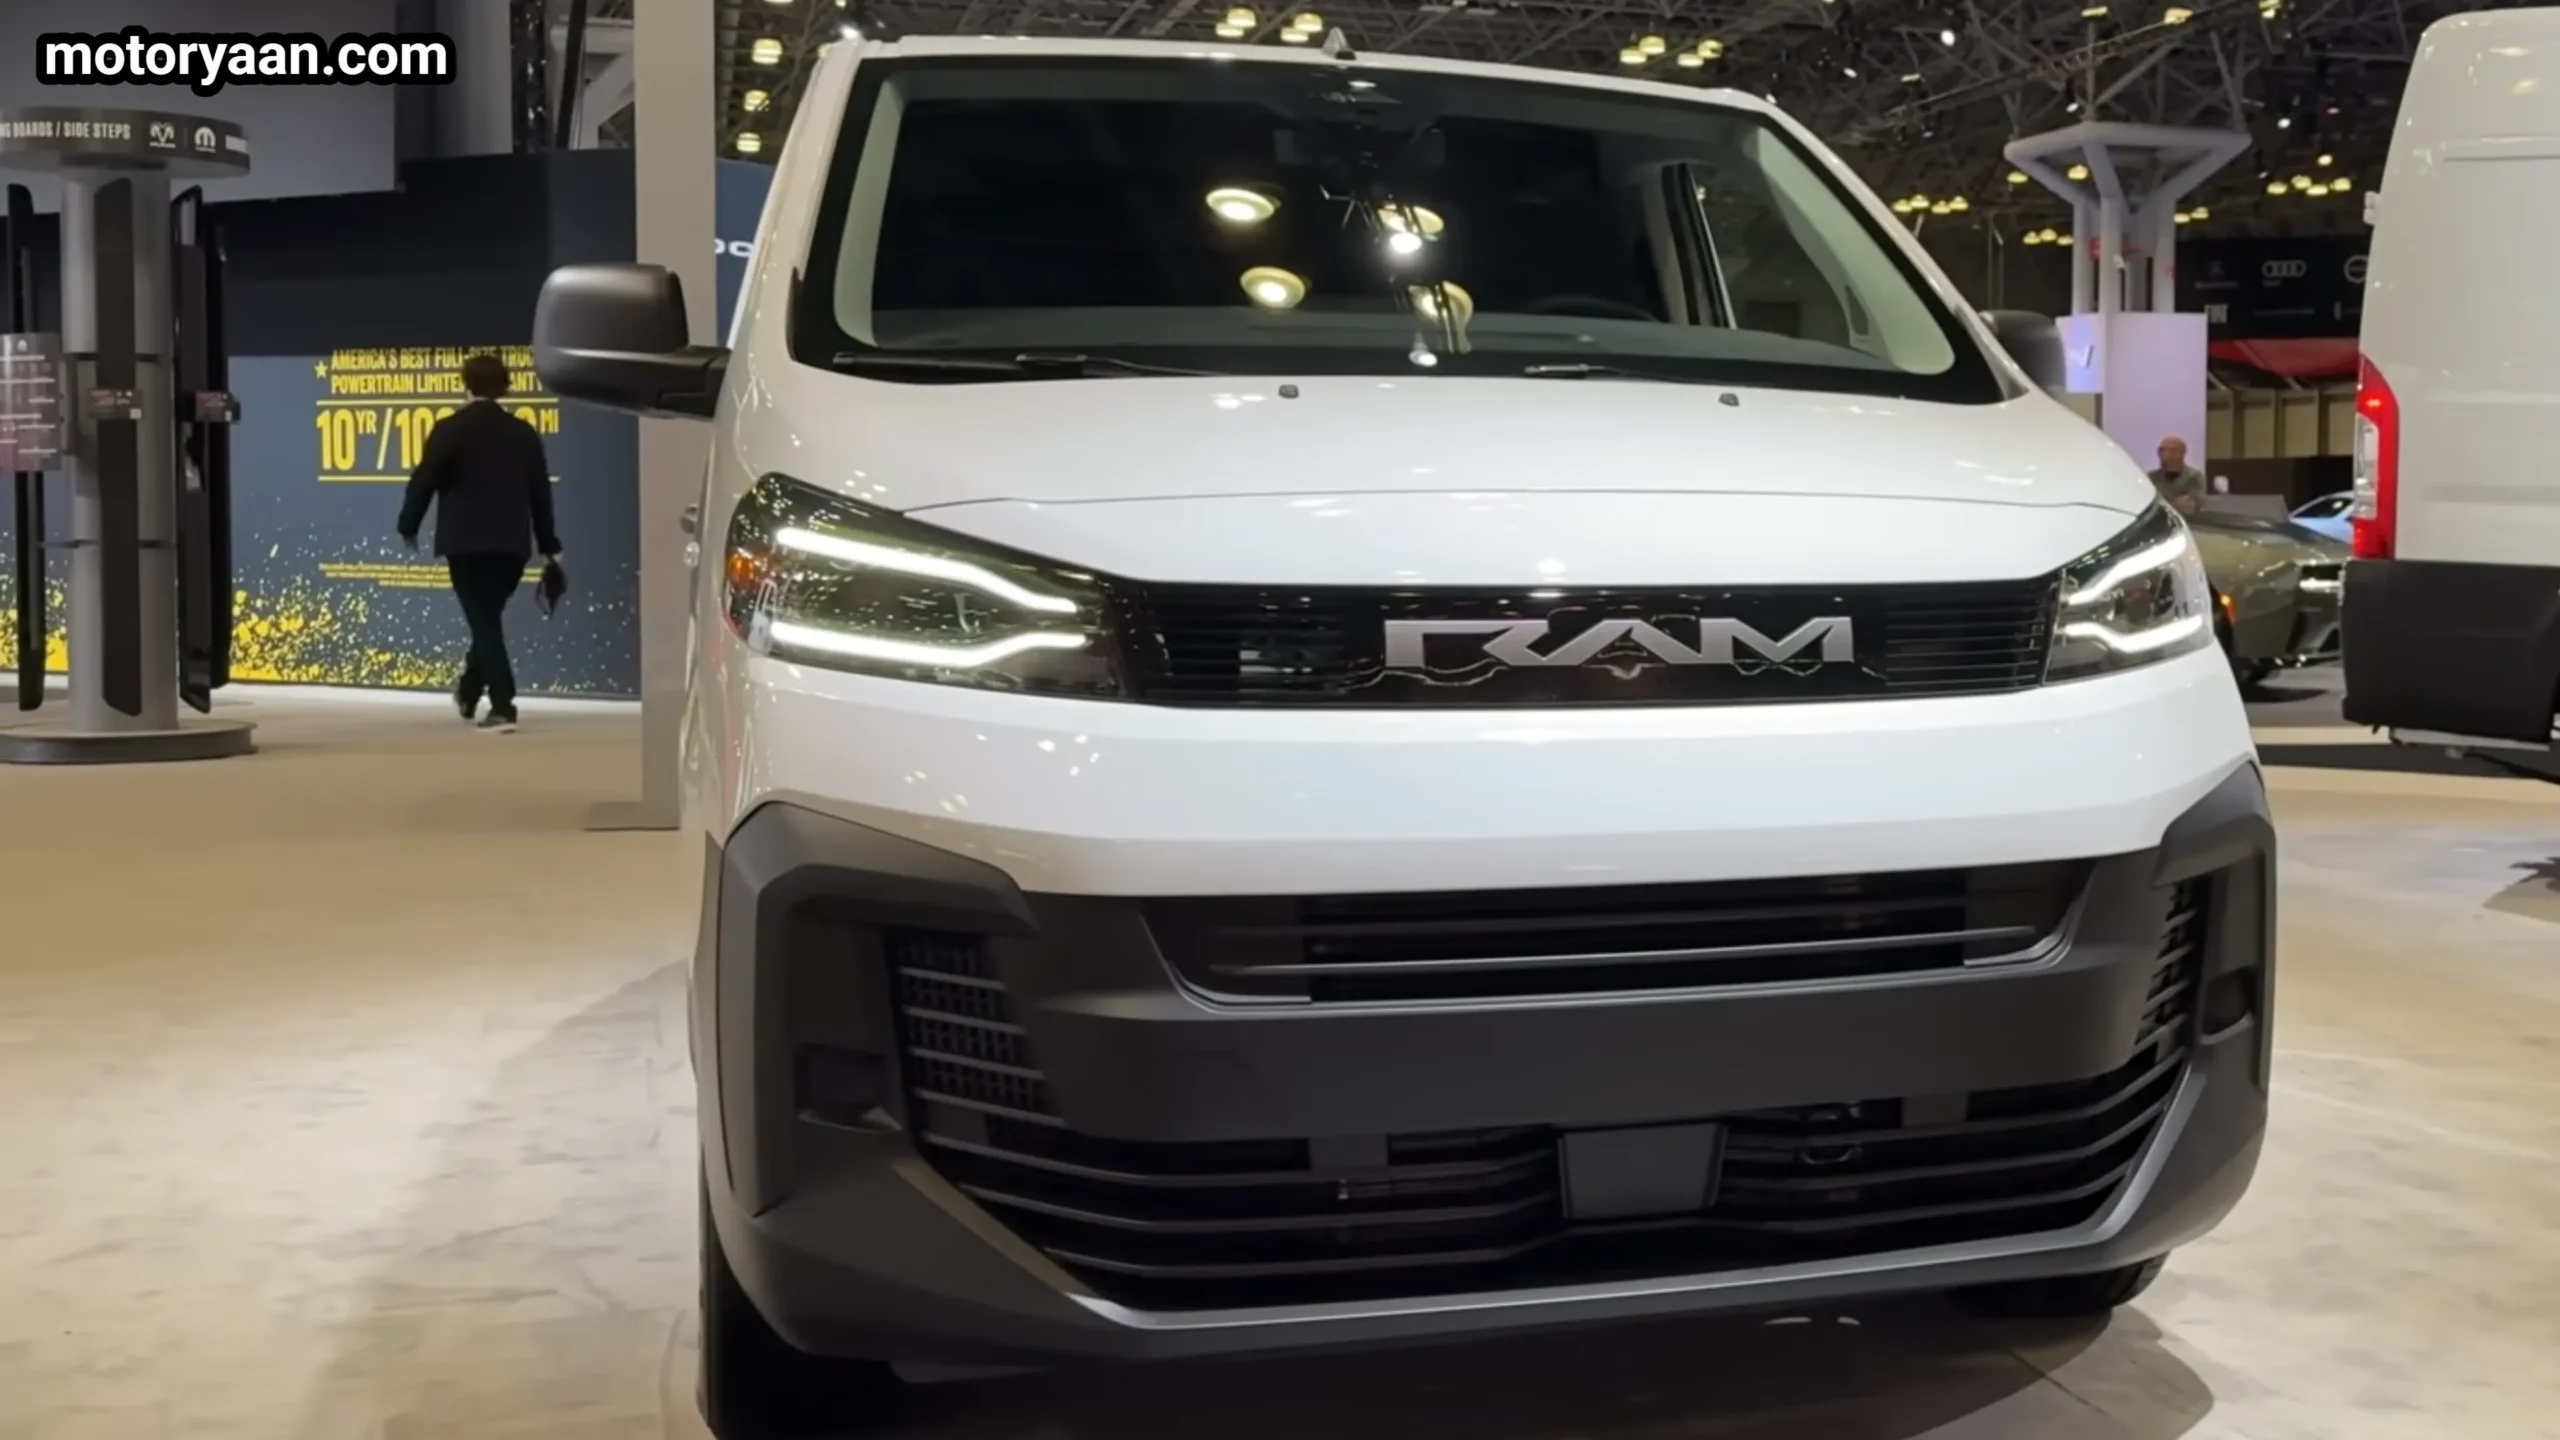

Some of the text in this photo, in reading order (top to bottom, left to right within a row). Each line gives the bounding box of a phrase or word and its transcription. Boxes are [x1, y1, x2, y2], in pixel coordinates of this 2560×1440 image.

[63, 121, 90, 139] SIDE
[92, 122, 131, 140] STEPS
[331, 349, 398, 370] AMERICA'S
[400, 347, 431, 369] BEST
[500, 345, 535, 368] TRUC
[331, 374, 414, 394] POWERTRAIN
[1384, 616, 1854, 667] RAM
